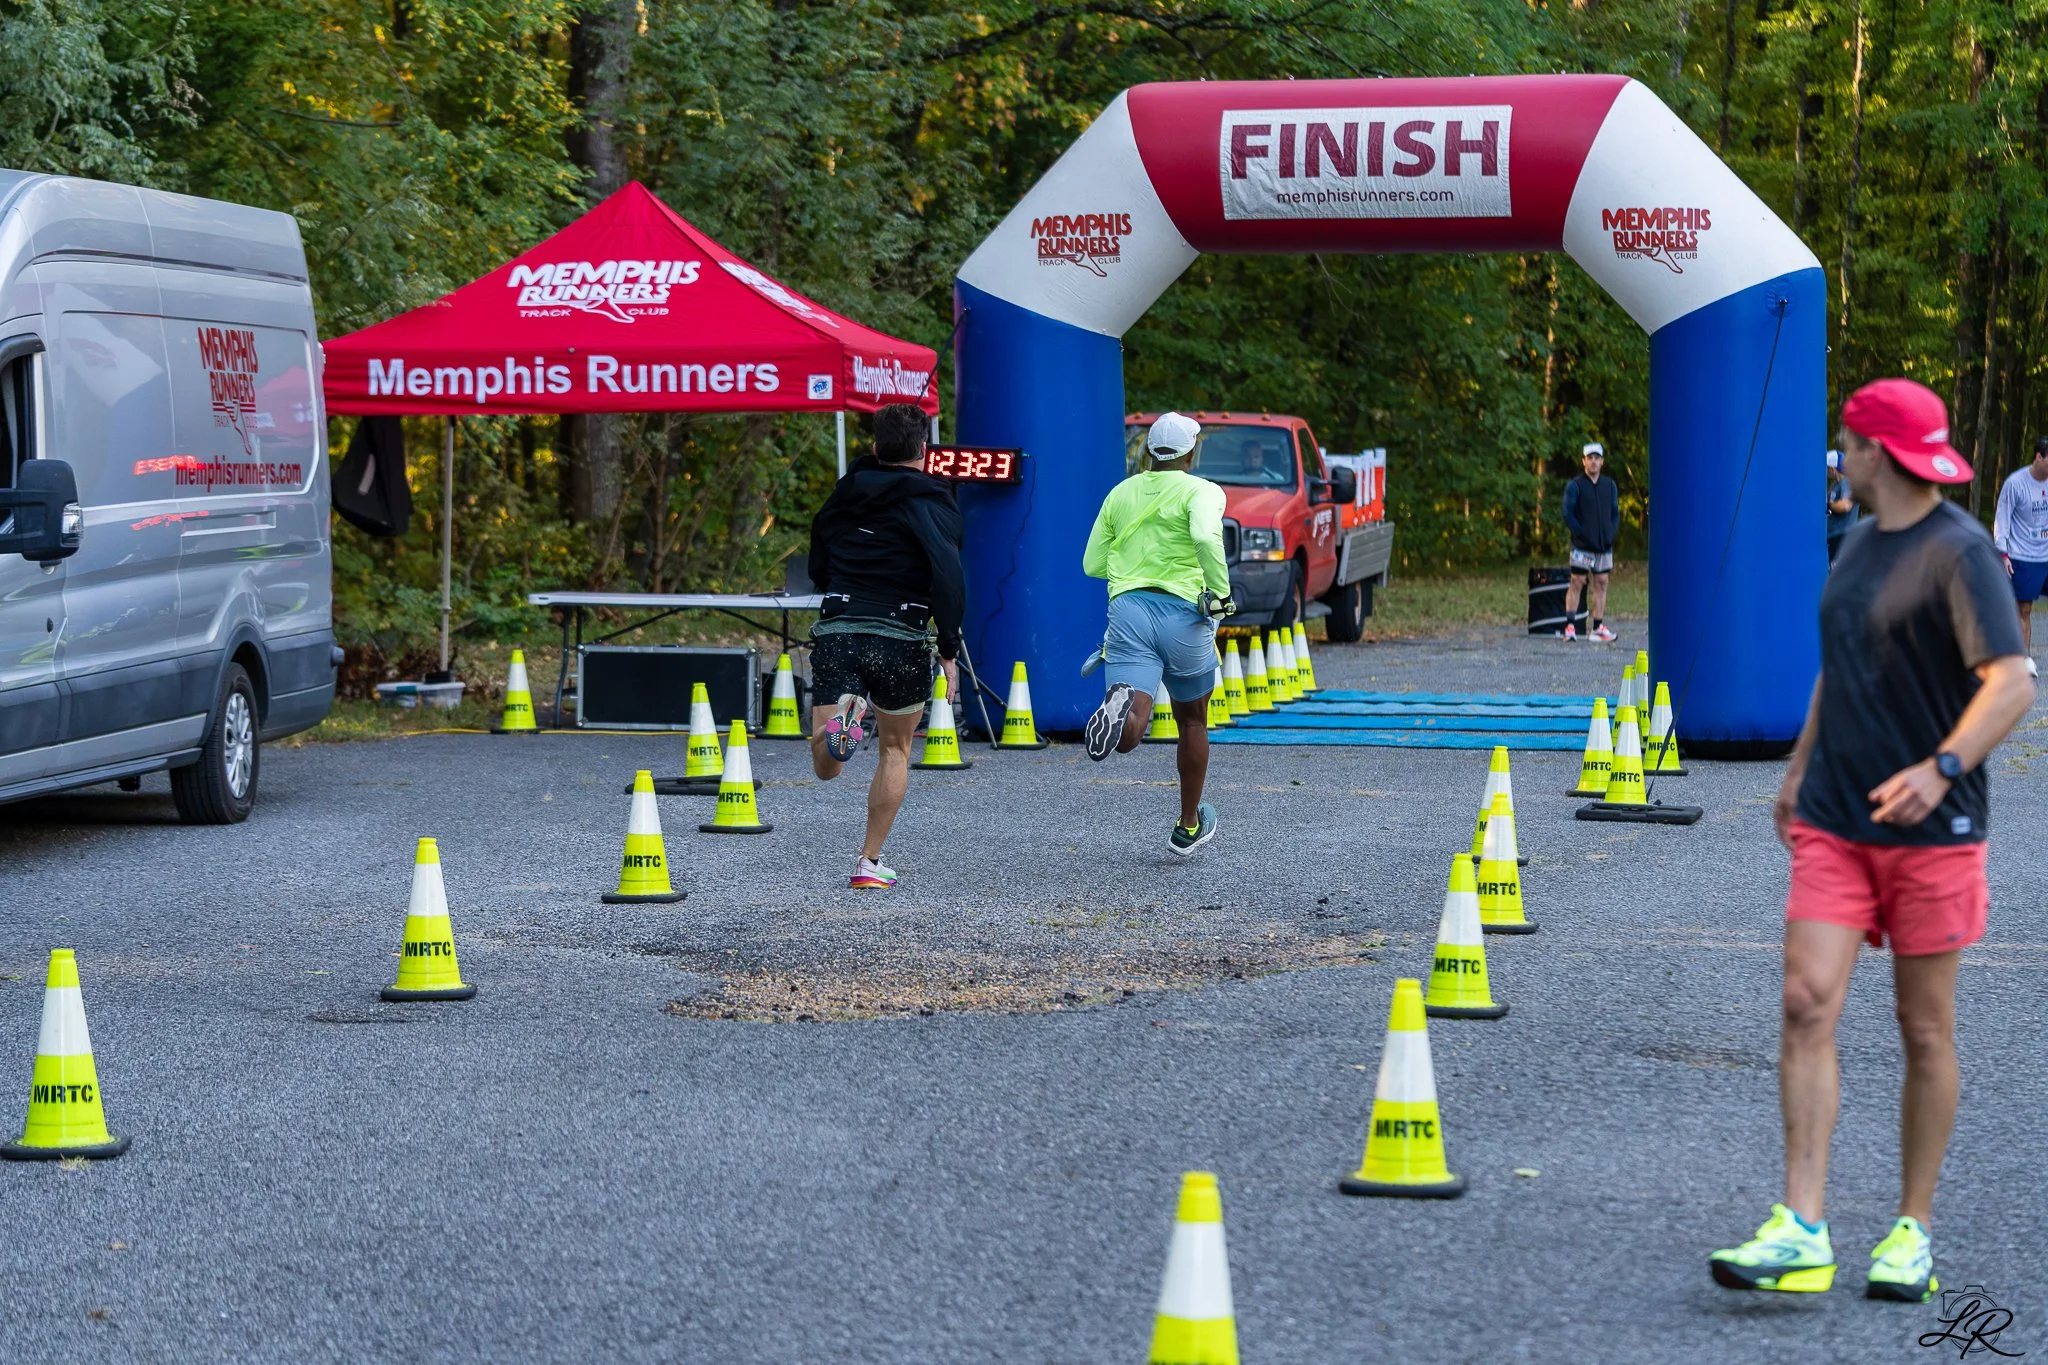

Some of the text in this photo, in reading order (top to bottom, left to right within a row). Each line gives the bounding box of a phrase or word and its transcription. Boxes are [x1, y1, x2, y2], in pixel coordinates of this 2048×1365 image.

[1230, 120, 1501, 180] FINISH
[1276, 188, 1455, 206] memphisrunners.com
[1030, 213, 1132, 239] MEMPHIS
[1602, 207, 1712, 231] MEMPHIS
[1037, 236, 1120, 256] RUNNERS
[1612, 231, 1698, 250] RUNNERS
[1038, 256, 1121, 267] TRACK CLUB
[1615, 252, 1698, 260] TRACK CLUB
[506, 260, 701, 288] MEMPHIS
[516, 283, 672, 304] RUNNERS
[519, 307, 670, 318] TRACK CLUB
[197, 326, 259, 374] MEMPHIS
[209, 371, 256, 403] RUNNERS
[367, 354, 780, 405] Memphis Runners
[853, 356, 930, 403] Memphis Runners
[927, 451, 1012, 479] 1:23:23
[175, 455, 302, 493] memphisrunners.com
[504, 703, 529, 712] MRTC
[769, 708, 795, 718] MRTC
[1004, 717, 1031, 727] MRTC
[1153, 711, 1174, 721] MRT
[926, 735, 954, 745] MRTC
[1649, 742, 1676, 751] MRC
[690, 746, 720, 757] MRTC
[1583, 761, 1612, 771] MRTC
[1610, 772, 1641, 783] MRTC
[718, 792, 750, 804] MRTC
[623, 855, 662, 868] MRTC
[1477, 882, 1517, 896] MRTC
[405, 941, 452, 957] MRTC
[1434, 958, 1481, 974] MRTC
[33, 1084, 94, 1104] MRTC
[1375, 1119, 1435, 1139] MRTC
